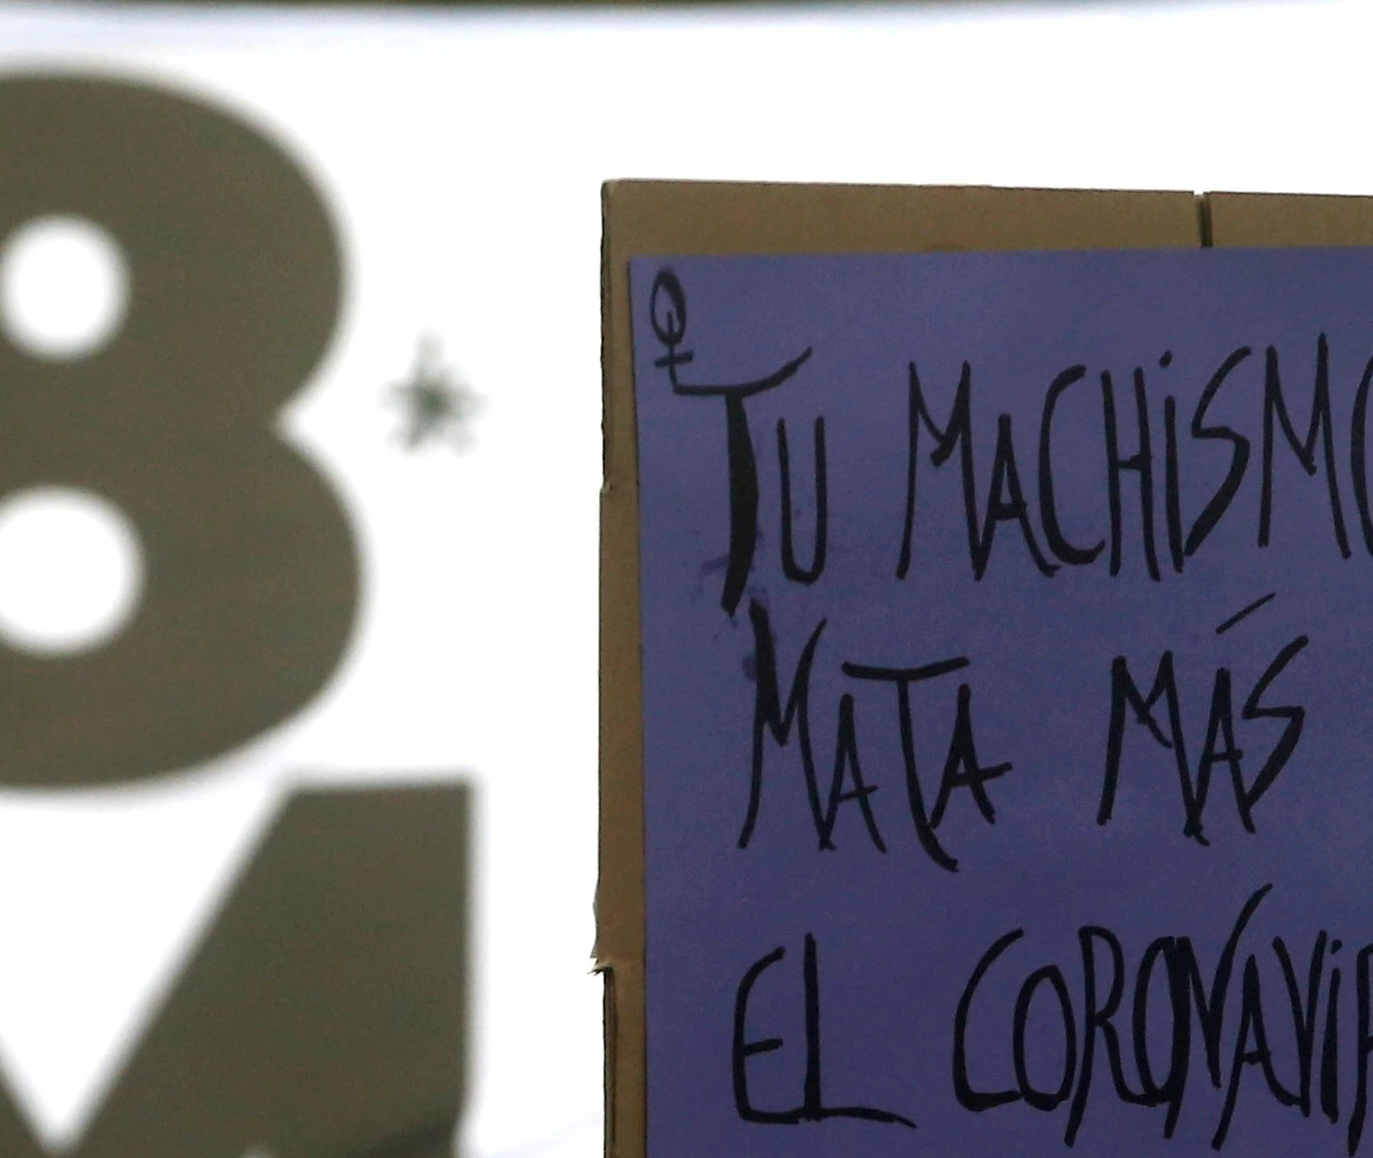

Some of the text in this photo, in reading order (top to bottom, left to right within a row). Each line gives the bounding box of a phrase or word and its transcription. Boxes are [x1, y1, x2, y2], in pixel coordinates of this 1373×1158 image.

[672, 346, 829, 614] TU
[736, 598, 1015, 874] MATA
[1096, 592, 1310, 847] MÁS
[728, 931, 919, 1131] EL
